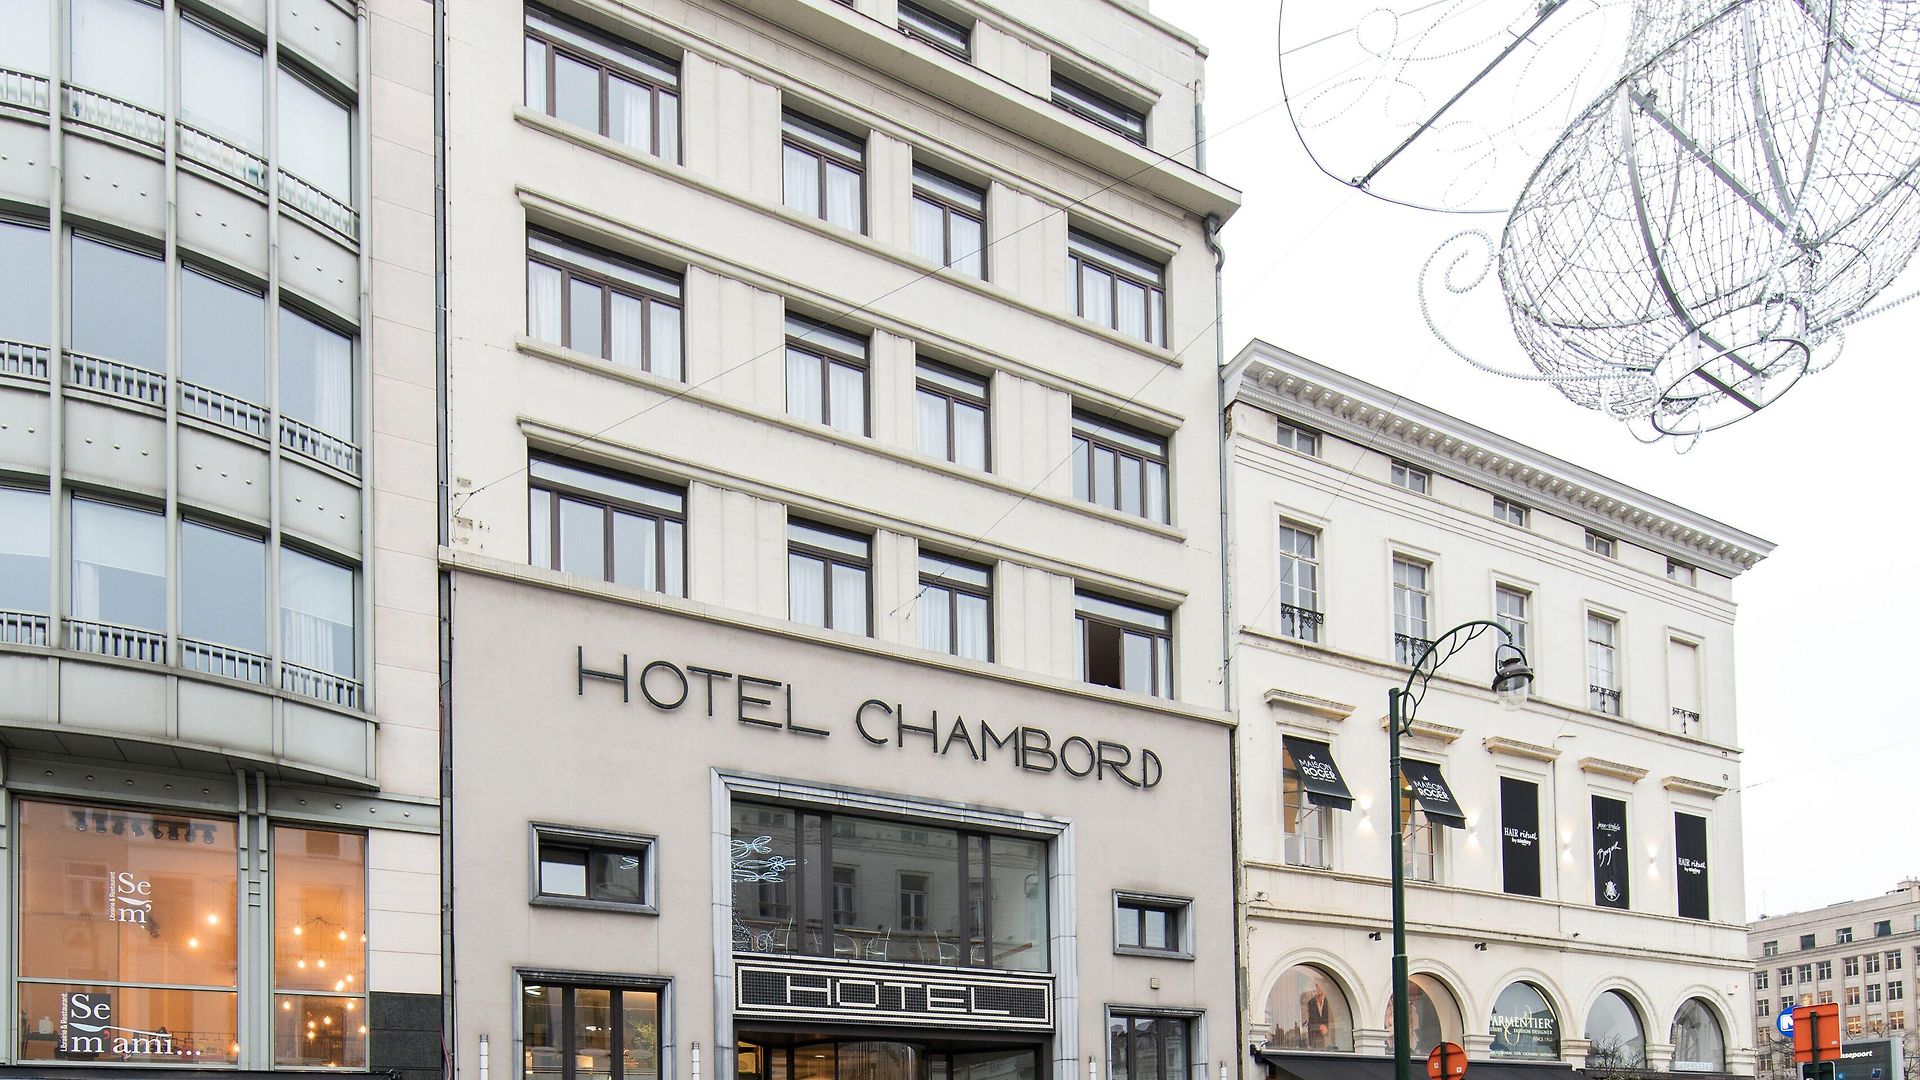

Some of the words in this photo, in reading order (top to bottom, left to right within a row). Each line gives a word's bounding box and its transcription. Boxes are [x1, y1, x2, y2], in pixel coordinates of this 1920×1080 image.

[578, 646, 829, 737] HOTEL
[855, 699, 1163, 789] CHAMBORD
[1298, 758, 1333, 771] MAISON
[1302, 766, 1338, 780] ROGER
[1413, 780, 1445, 792] MAISON
[1417, 787, 1450, 800] ROGER
[1504, 827, 1518, 837] HAIR
[118, 872, 152, 895] Se
[785, 975, 1010, 1016] HOTEL
[71, 993, 111, 1020] Se
